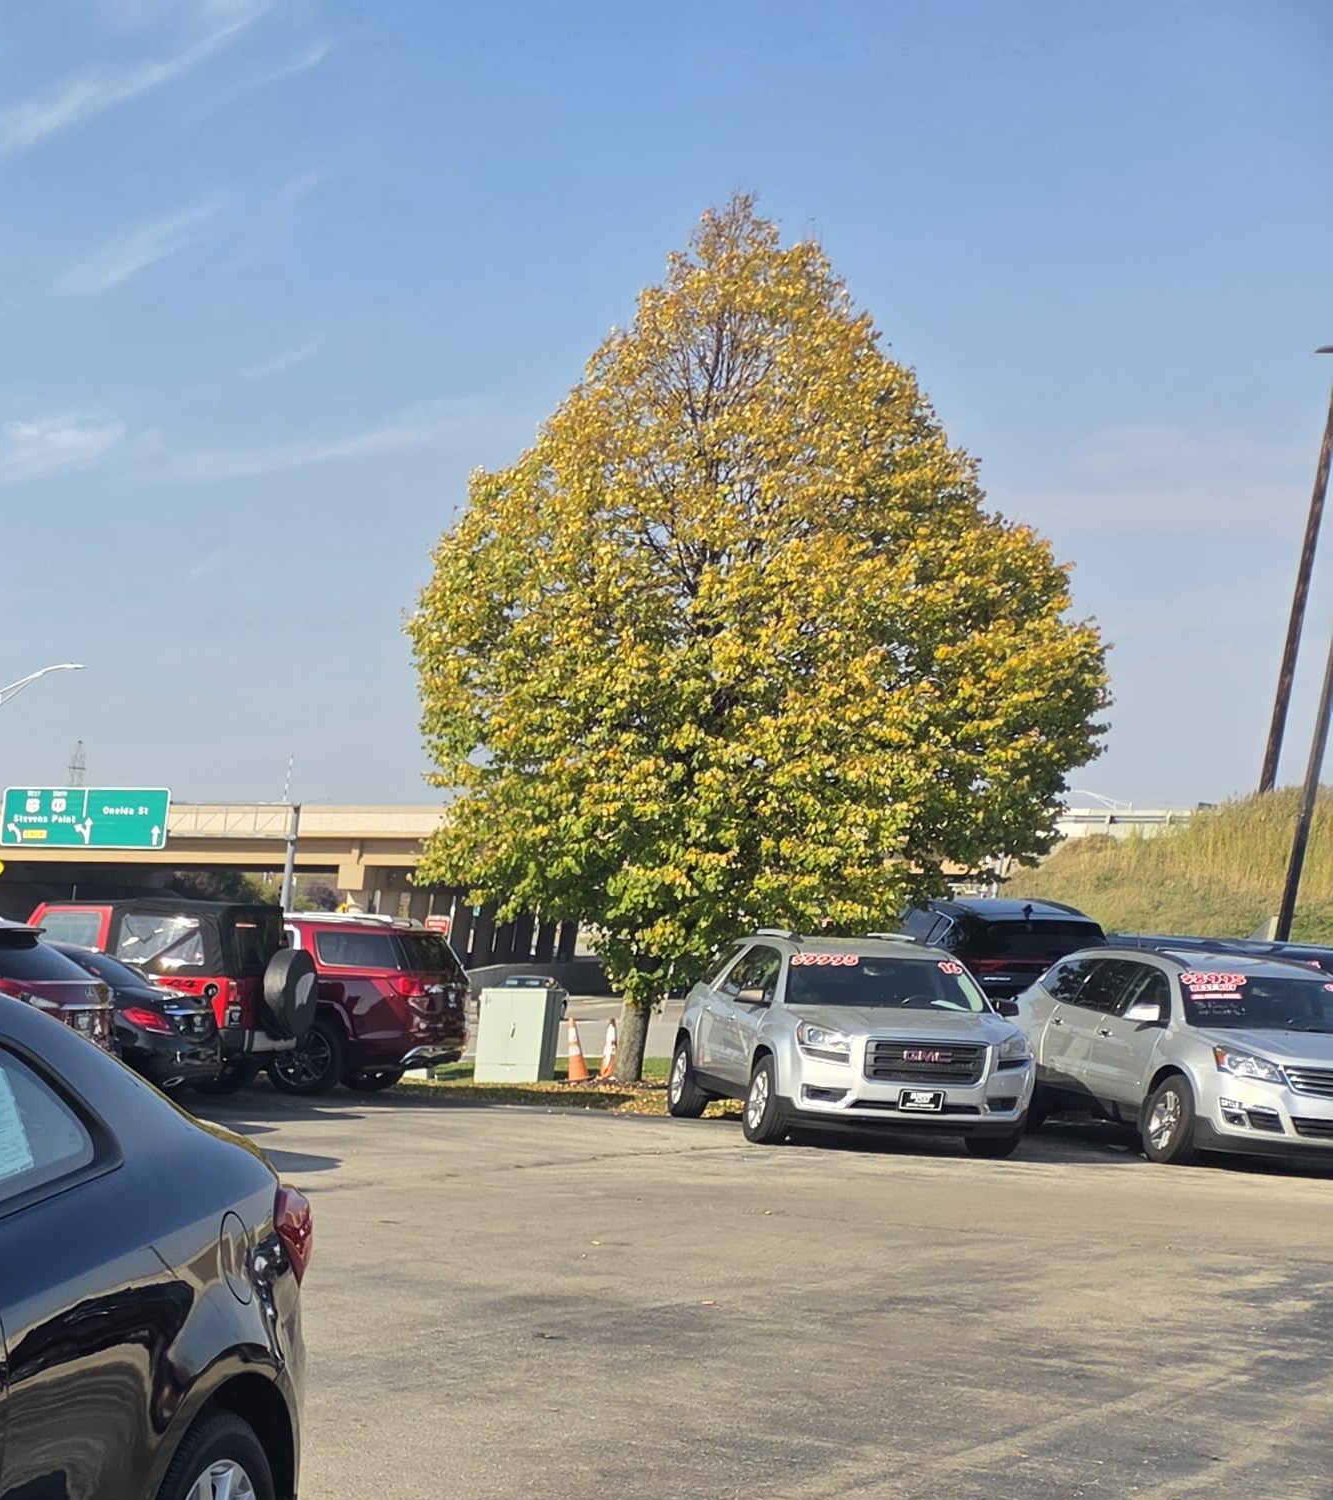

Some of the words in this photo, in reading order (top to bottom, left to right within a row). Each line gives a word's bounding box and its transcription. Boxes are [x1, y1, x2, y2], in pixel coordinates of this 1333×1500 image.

[102, 806, 134, 815] Oneida
[138, 806, 149, 815] St
[13, 814, 48, 823] Stevens
[51, 814, 76, 823] Point
[791, 954, 859, 966] $9995
[938, 962, 963, 974] 16
[1180, 973, 1247, 985] $8995
[903, 1050, 952, 1062] GMC
